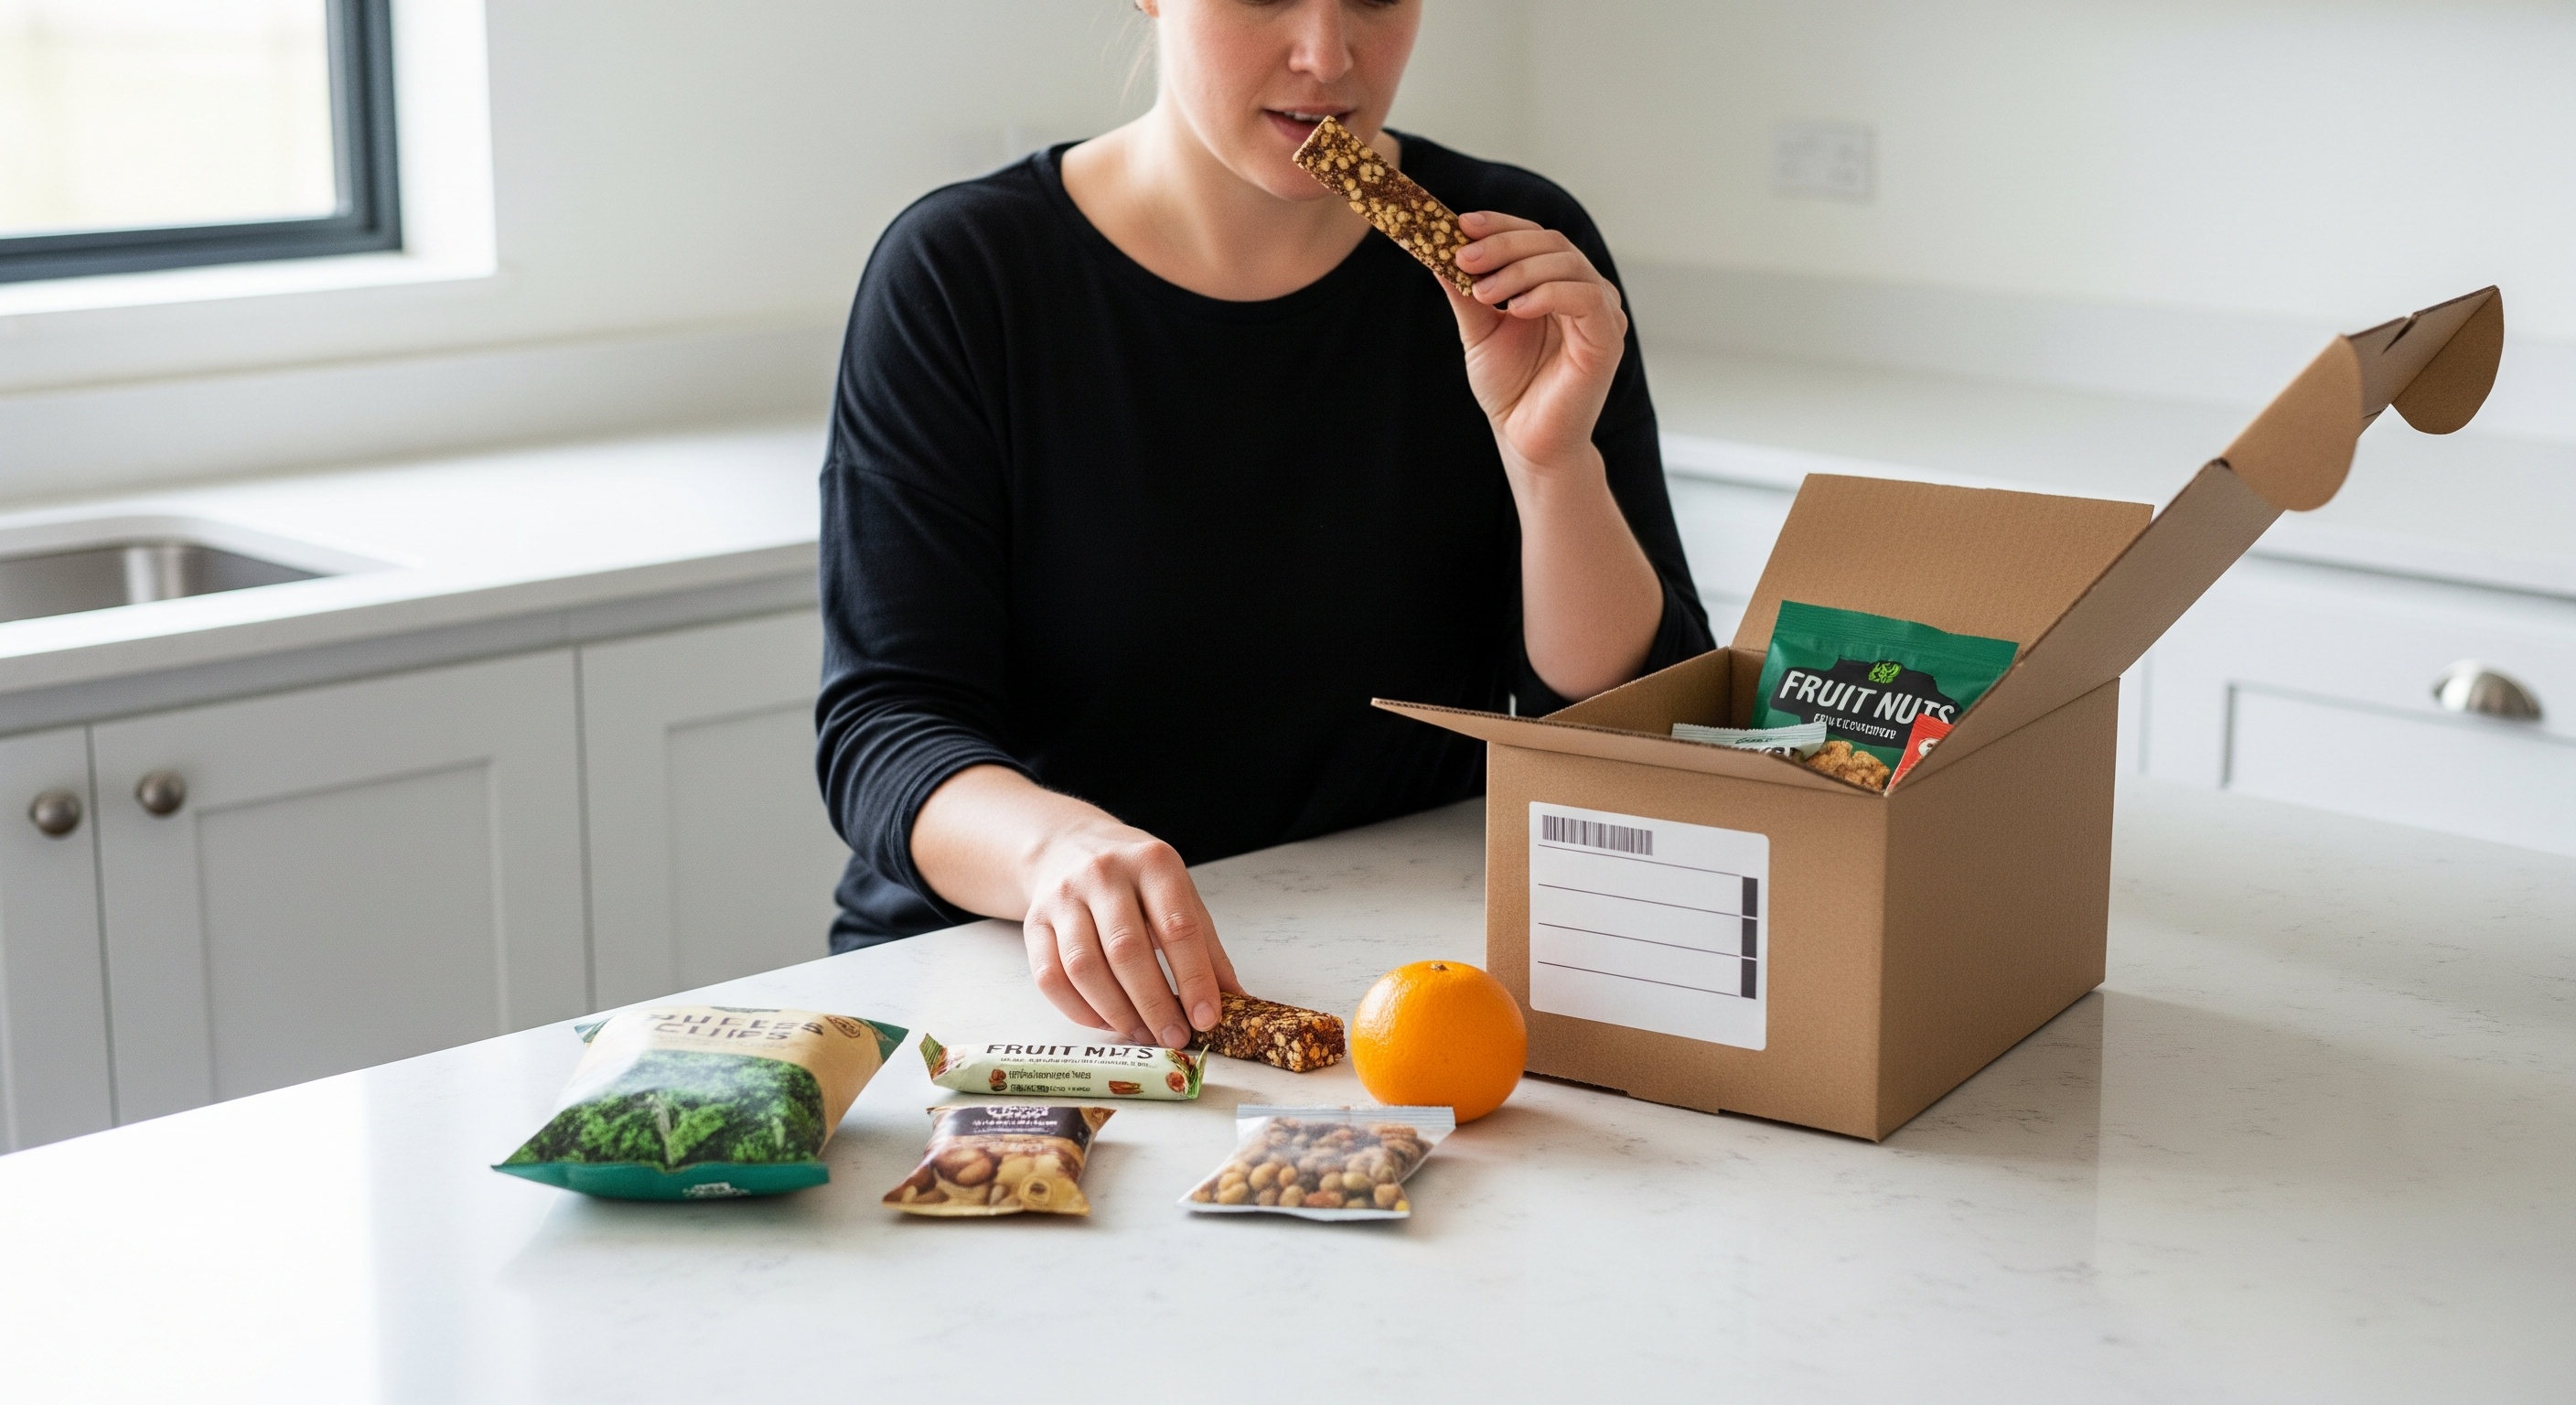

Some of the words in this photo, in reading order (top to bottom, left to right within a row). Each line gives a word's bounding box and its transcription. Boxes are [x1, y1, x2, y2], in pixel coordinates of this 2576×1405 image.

[1779, 670, 1878, 714] FRUIT
[1873, 692, 1956, 725] NUTS
[986, 1044, 1079, 1056] FRUIT
